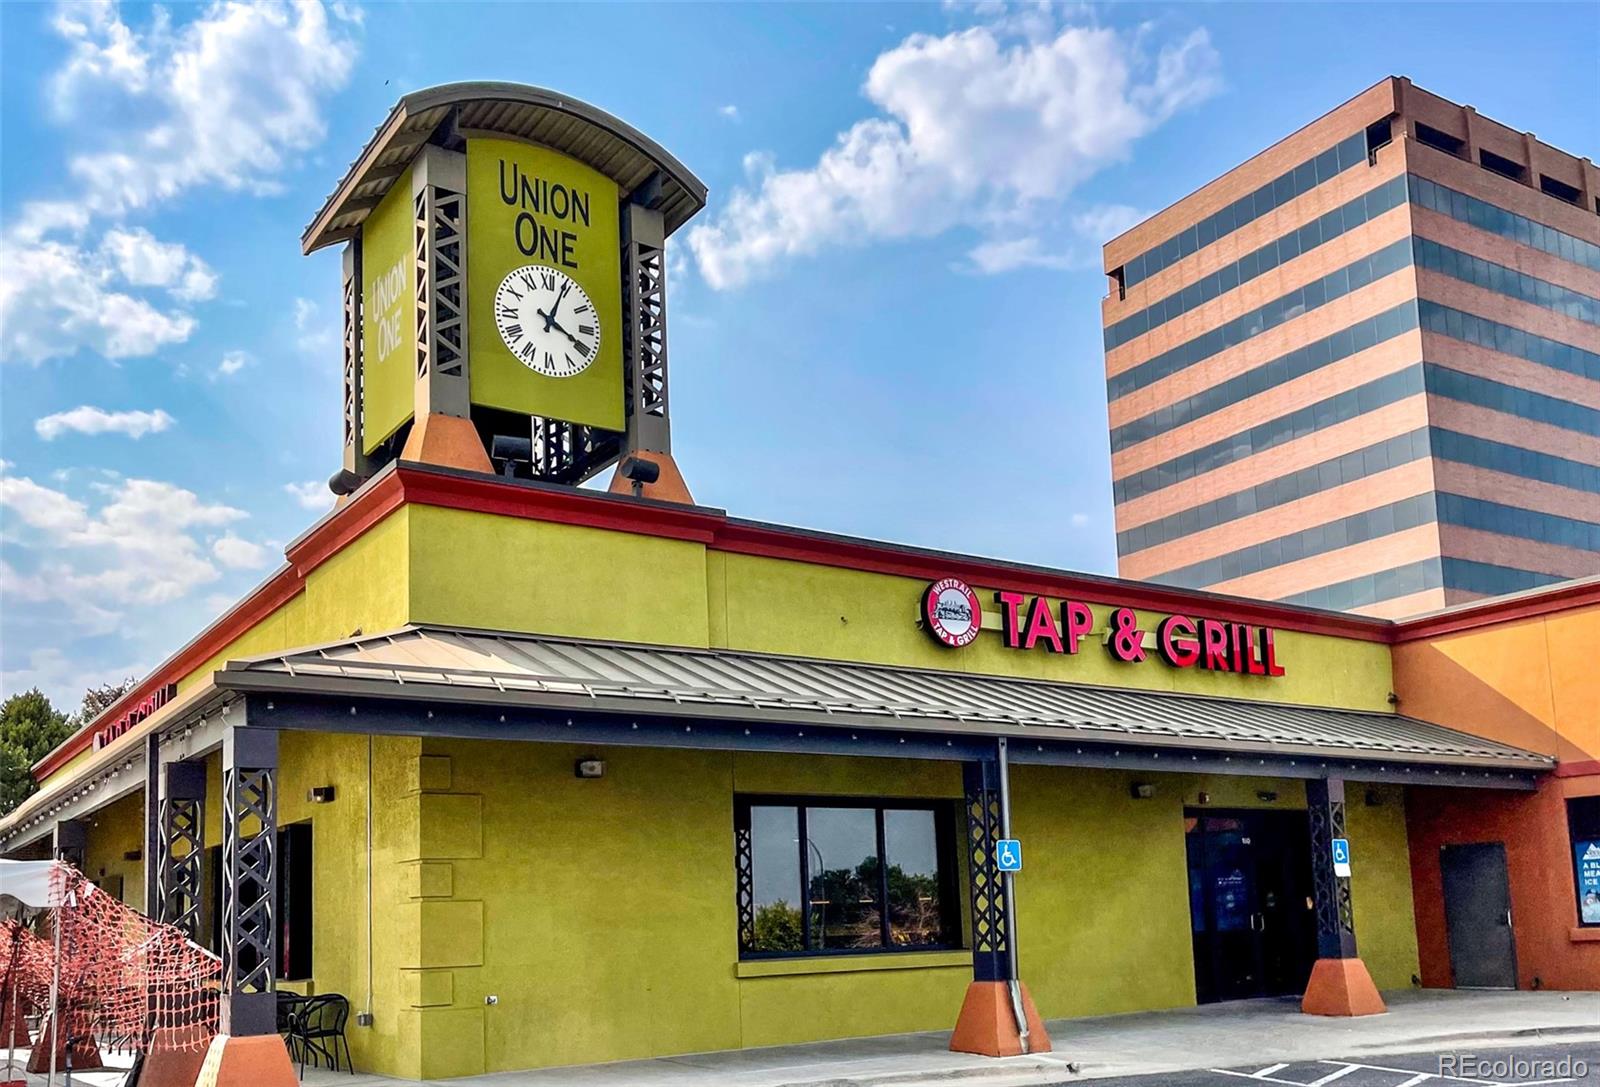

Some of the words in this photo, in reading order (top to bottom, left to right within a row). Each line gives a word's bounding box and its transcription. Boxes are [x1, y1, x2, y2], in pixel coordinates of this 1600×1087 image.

[499, 159, 589, 227] UNION
[515, 212, 577, 269] ONE
[372, 255, 407, 322] UNION
[520, 273, 537, 292] XI
[541, 272, 555, 292] XII
[506, 285, 524, 301] X
[502, 304, 519, 319] IX
[378, 304, 402, 362] ONE
[521, 341, 537, 362] VII
[544, 351, 555, 370] VI
[932, 579, 972, 599] WESTRAIL
[933, 623, 949, 639] TAP
[956, 624, 978, 646] GRILL
[999, 591, 1094, 655] TAP
[1113, 607, 1147, 662] &
[1162, 614, 1286, 677] GRILL
[1584, 878, 1599, 886] ICE
